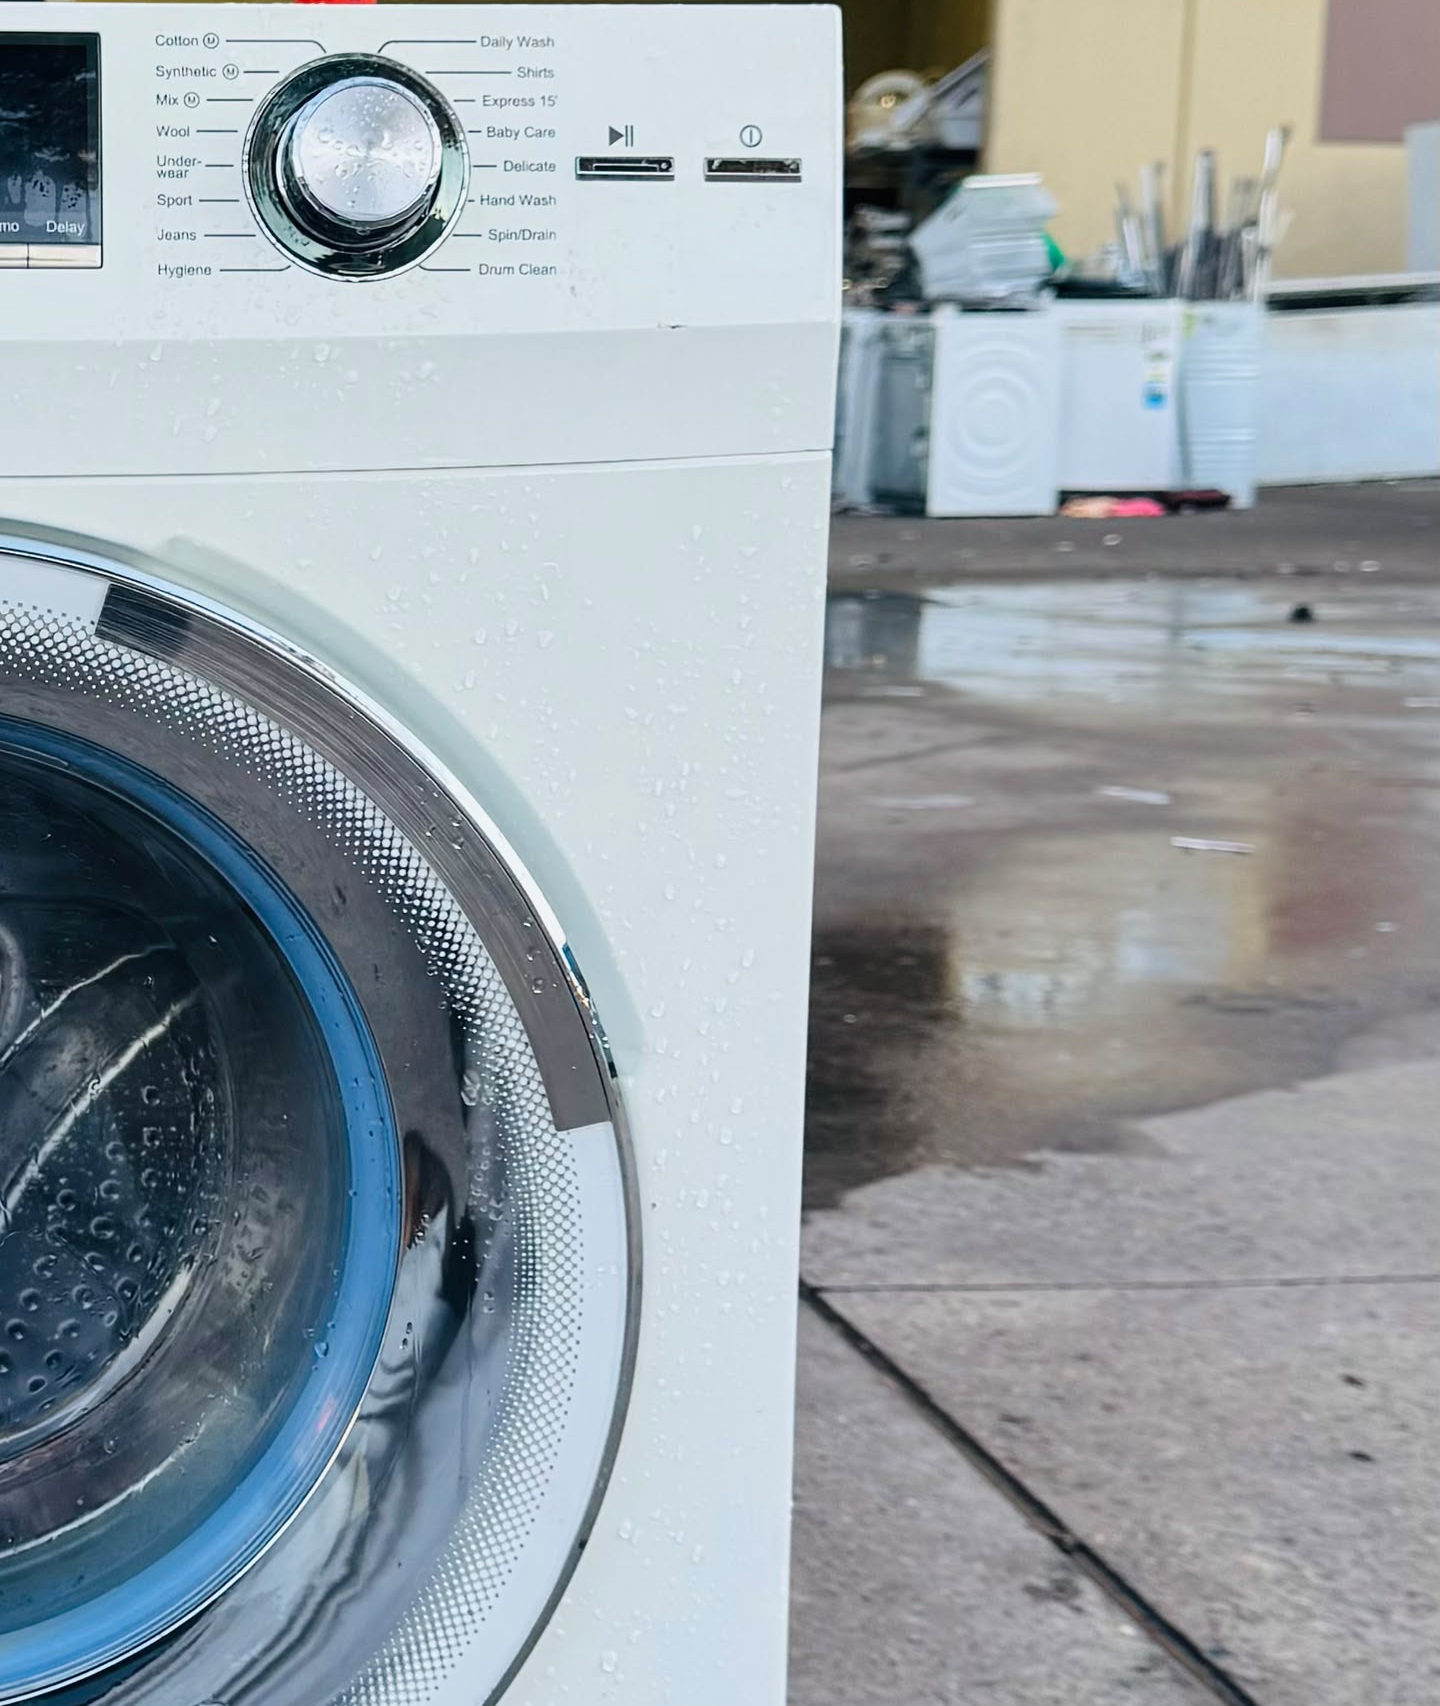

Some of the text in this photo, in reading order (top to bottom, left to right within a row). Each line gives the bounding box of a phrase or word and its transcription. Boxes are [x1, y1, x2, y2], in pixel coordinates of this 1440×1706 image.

[155, 34, 199, 46] Cotton
[480, 35, 555, 51] Daily Wash
[155, 65, 217, 80] Synthetic
[517, 66, 555, 78] Shirts
[156, 94, 179, 106] Mix
[482, 94, 535, 109] Express
[156, 125, 190, 137] Wool
[486, 126, 556, 141] Baby Care
[156, 155, 202, 167] Under-
[503, 160, 557, 172] Delicate
[156, 169, 189, 179] wear
[156, 193, 193, 208] Sport
[480, 194, 557, 206] Hand Wash
[46, 220, 86, 236] Delay
[157, 229, 197, 241] Jeans
[488, 229, 557, 243] Spin/Drain
[158, 263, 212, 279] Hygiene
[478, 263, 557, 276] Drum Clean
